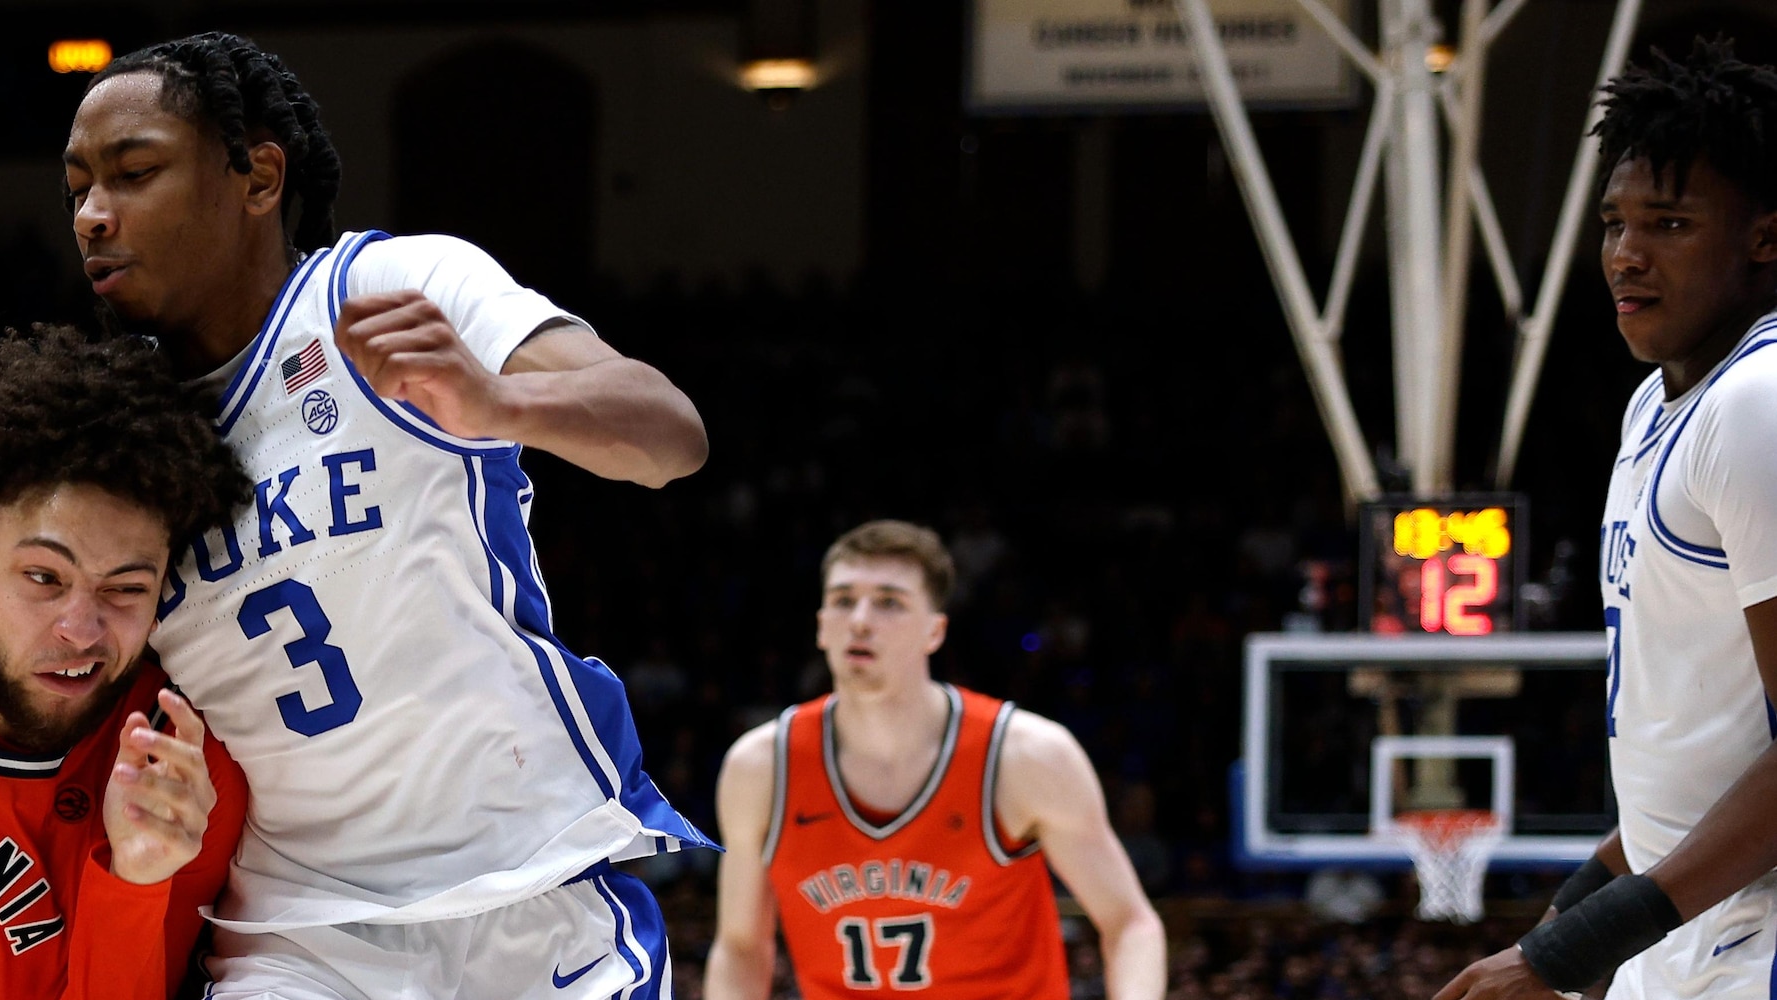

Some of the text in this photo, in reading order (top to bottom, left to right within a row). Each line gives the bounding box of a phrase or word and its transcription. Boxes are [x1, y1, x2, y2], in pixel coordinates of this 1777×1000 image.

[308, 396, 334, 421] ACC
[1419, 552, 1499, 636] 12
[236, 578, 364, 738] 3
[798, 858, 973, 914] VIRGINIA
[836, 912, 935, 991] 17
